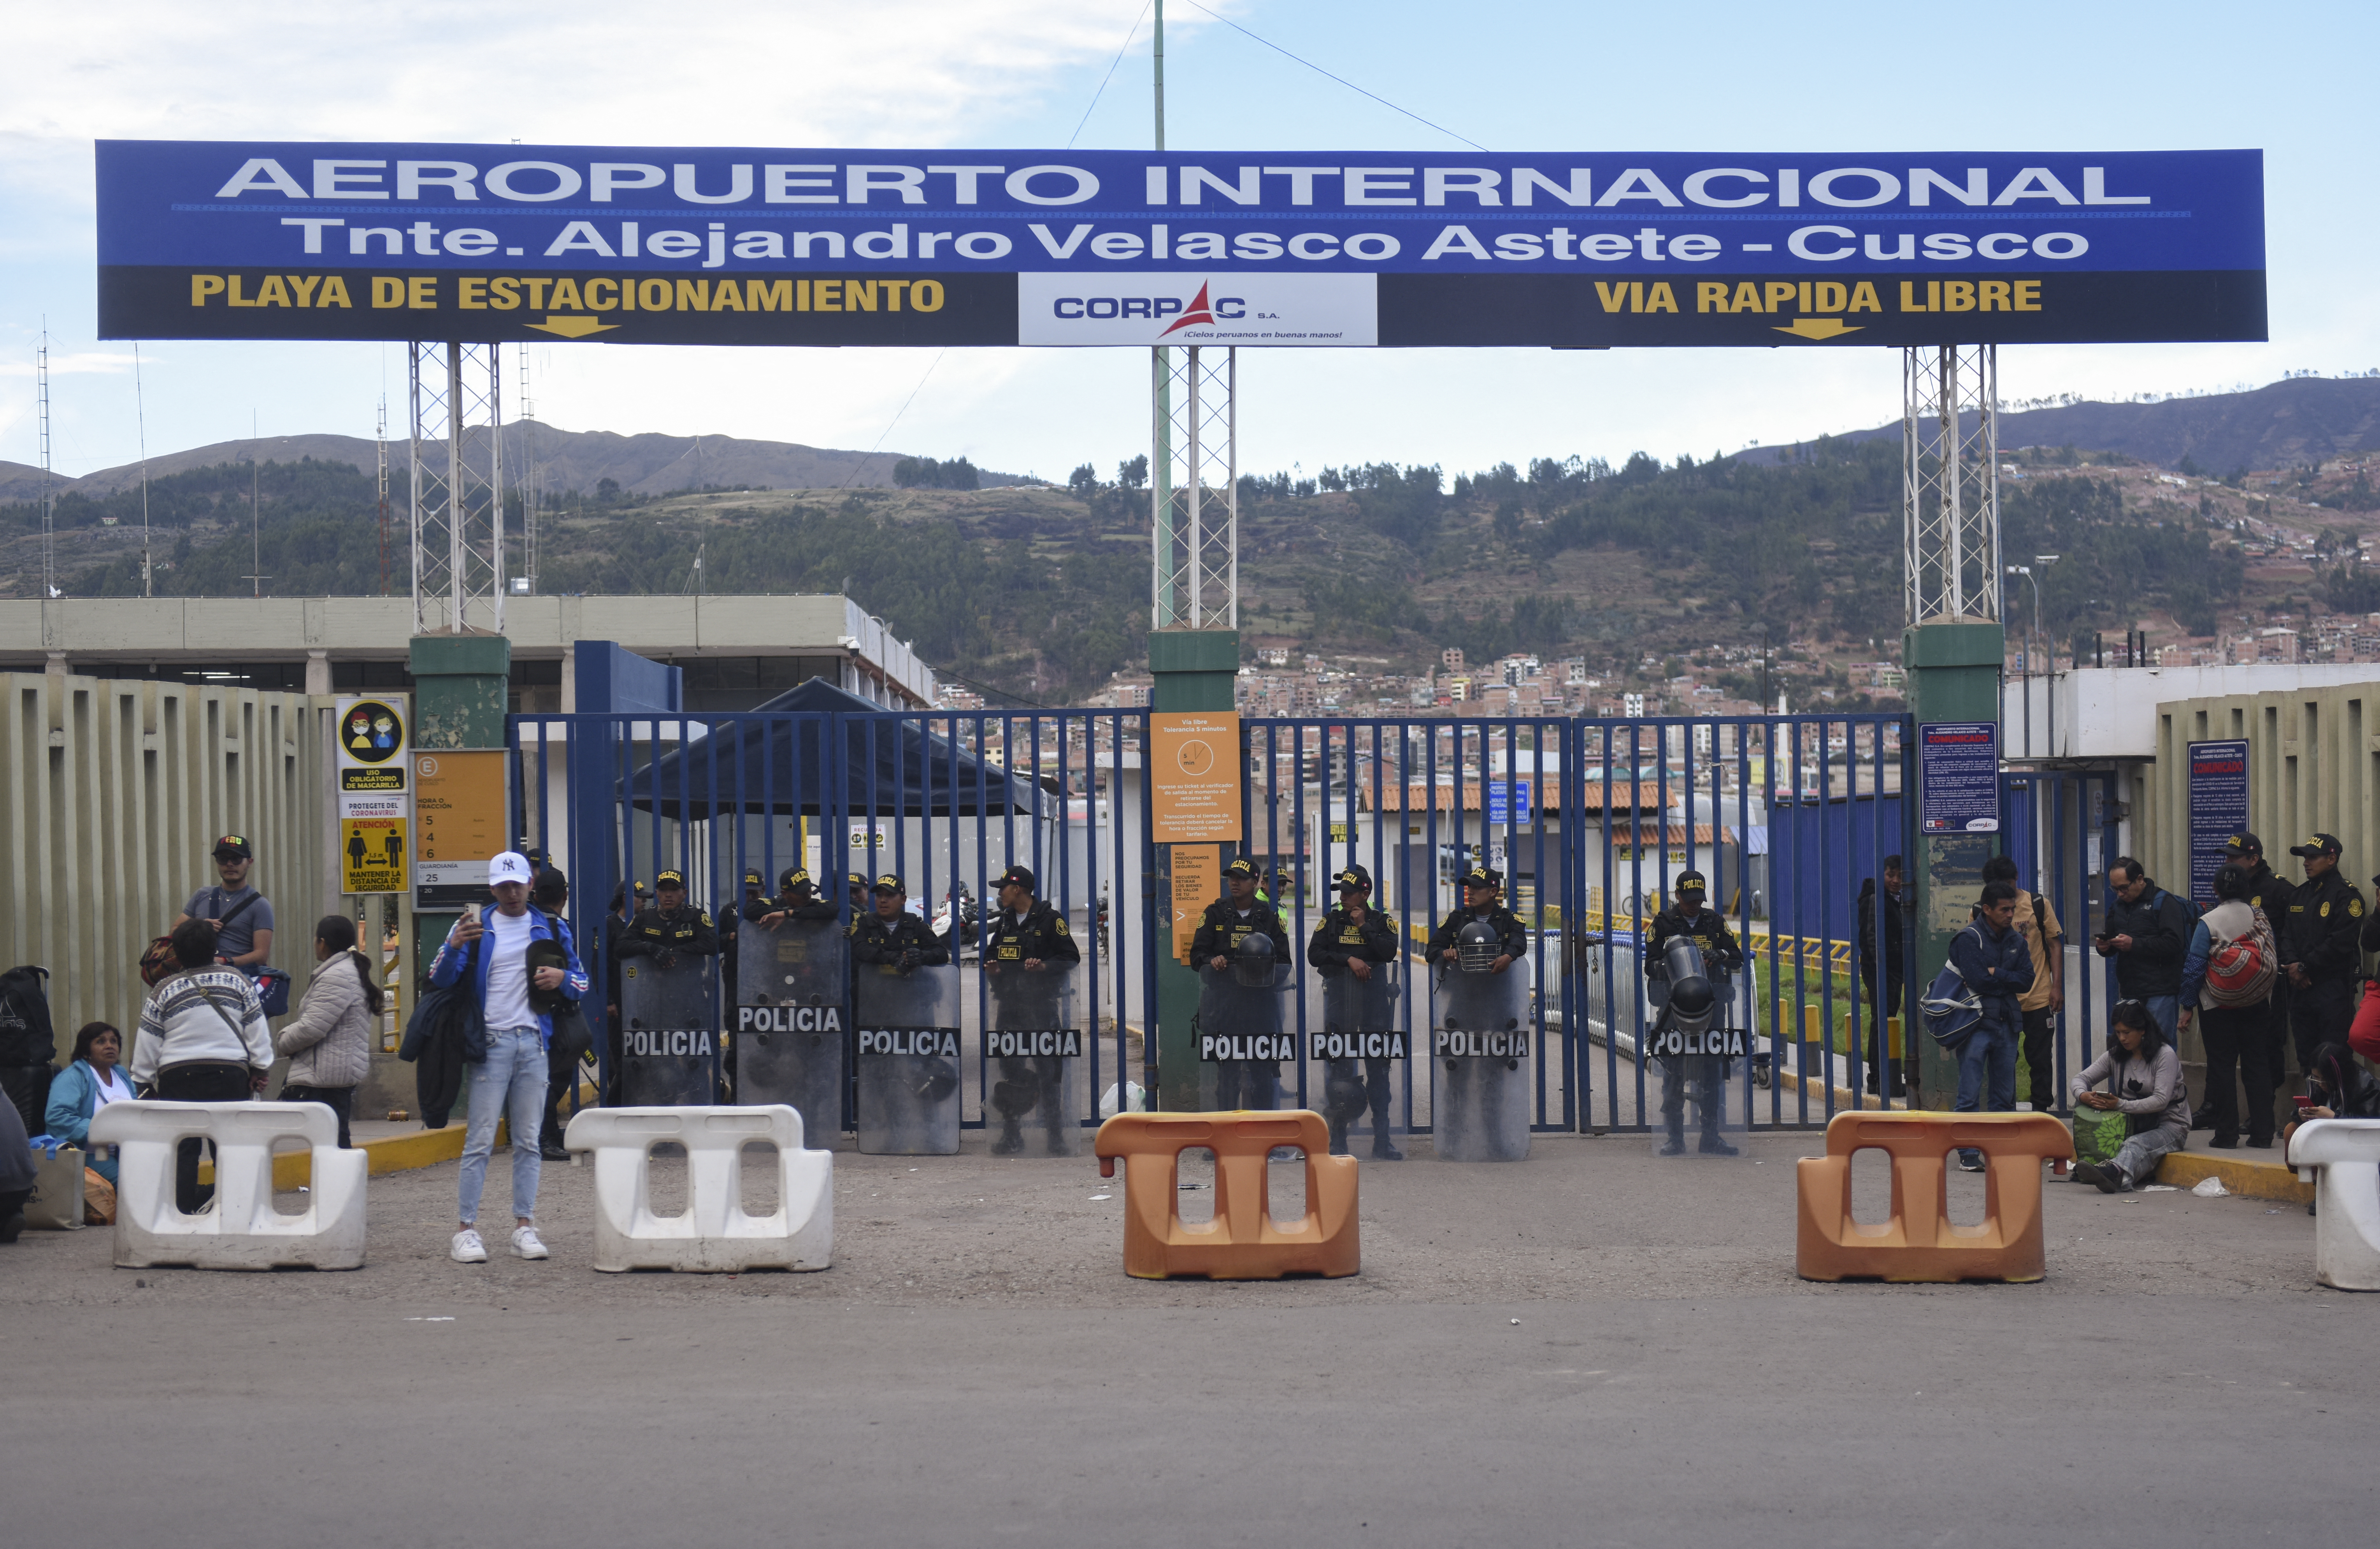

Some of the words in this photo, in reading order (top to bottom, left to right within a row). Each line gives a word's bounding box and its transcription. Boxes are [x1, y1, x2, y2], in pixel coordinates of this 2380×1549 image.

[215, 158, 1099, 205] AEROPUERTO
[1146, 166, 2151, 208] INTERNACIONAL
[281, 218, 523, 256] Tnte.
[543, 221, 1012, 268] Alejandro
[1027, 224, 1400, 261] Velasco
[1421, 225, 1721, 261] Astete
[1787, 225, 2089, 261] Cusco
[191, 274, 352, 308] PLAYA
[372, 277, 437, 309] DE
[459, 277, 944, 312] ESTACIONAMIENTO
[1594, 281, 1680, 313] VIA
[1697, 281, 1882, 313] RAPIDA
[1899, 280, 2042, 312] LIBRE
[1928, 735, 1989, 743] COMUNICADO
[423, 761, 432, 772] E
[2193, 761, 2243, 774] COMUNICADO
[352, 819, 395, 828] ATENCIÓN
[426, 816, 433, 825] 5
[426, 833, 434, 842] 4
[427, 849, 434, 858] 6
[503, 858, 515, 871] NY
[658, 871, 681, 882] POLICIA
[745, 875, 758, 883] LICIA
[1342, 872, 1357, 885] LICIA
[1471, 868, 1486, 880] LICIA
[1683, 879, 1705, 890] POLICIA
[1000, 948, 1017, 957] POLICIA
[738, 1007, 841, 1031] POLICIA
[624, 1031, 712, 1056] POLICIA
[859, 1030, 958, 1056] POLICIA
[988, 1032, 1077, 1056] POLICIA
[1202, 1035, 1293, 1060] POLICIA
[1314, 1034, 1404, 1057] POLICIA
[1435, 1031, 1527, 1056] POLICIA
[1654, 1030, 1744, 1054] POLICIA
